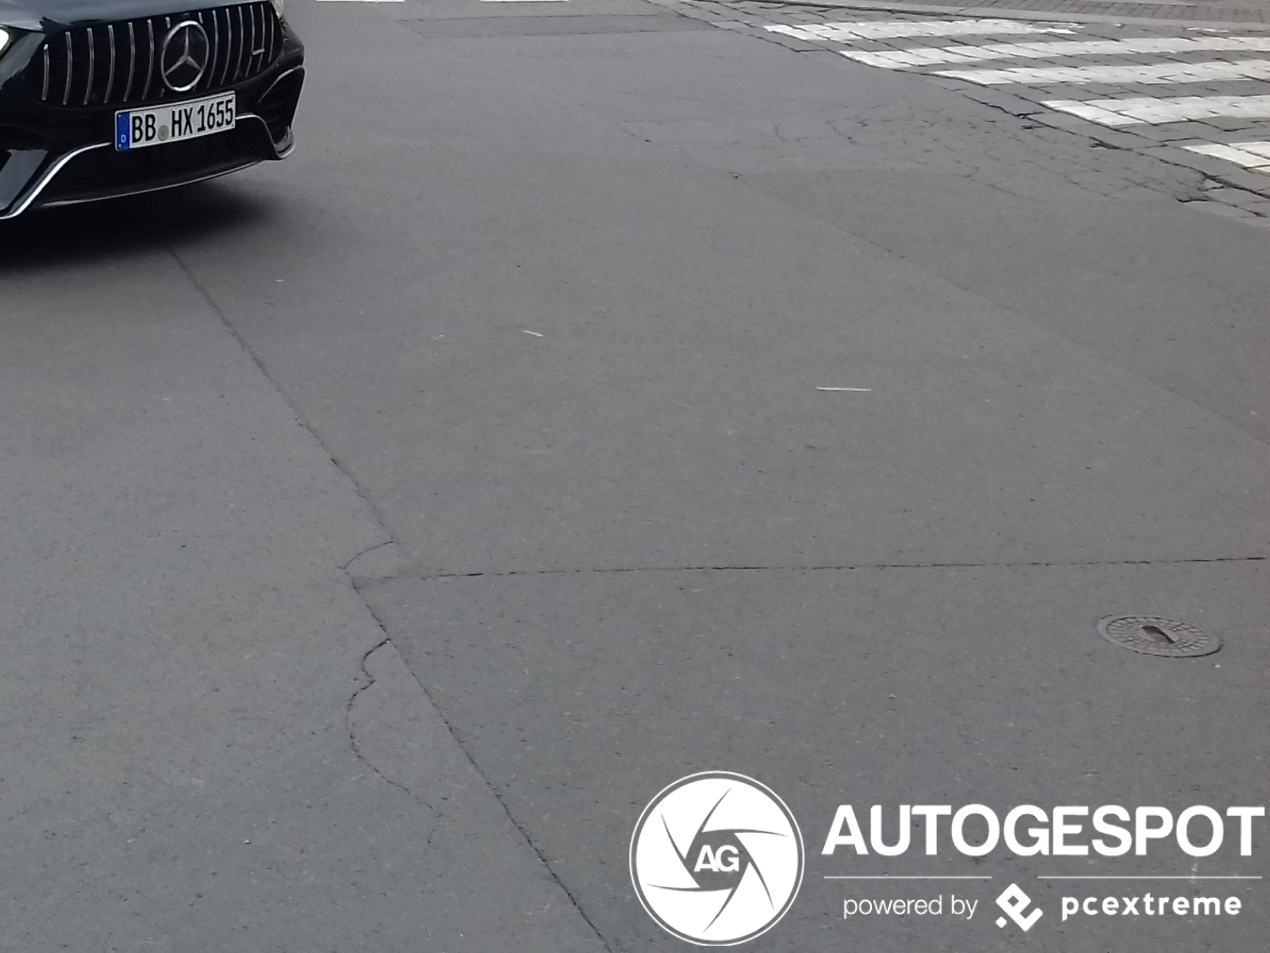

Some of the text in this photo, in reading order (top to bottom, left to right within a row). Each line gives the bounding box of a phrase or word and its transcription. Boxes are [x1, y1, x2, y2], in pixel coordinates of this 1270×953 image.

[131, 99, 234, 144] BB HX 1655
[121, 135, 127, 144] D
